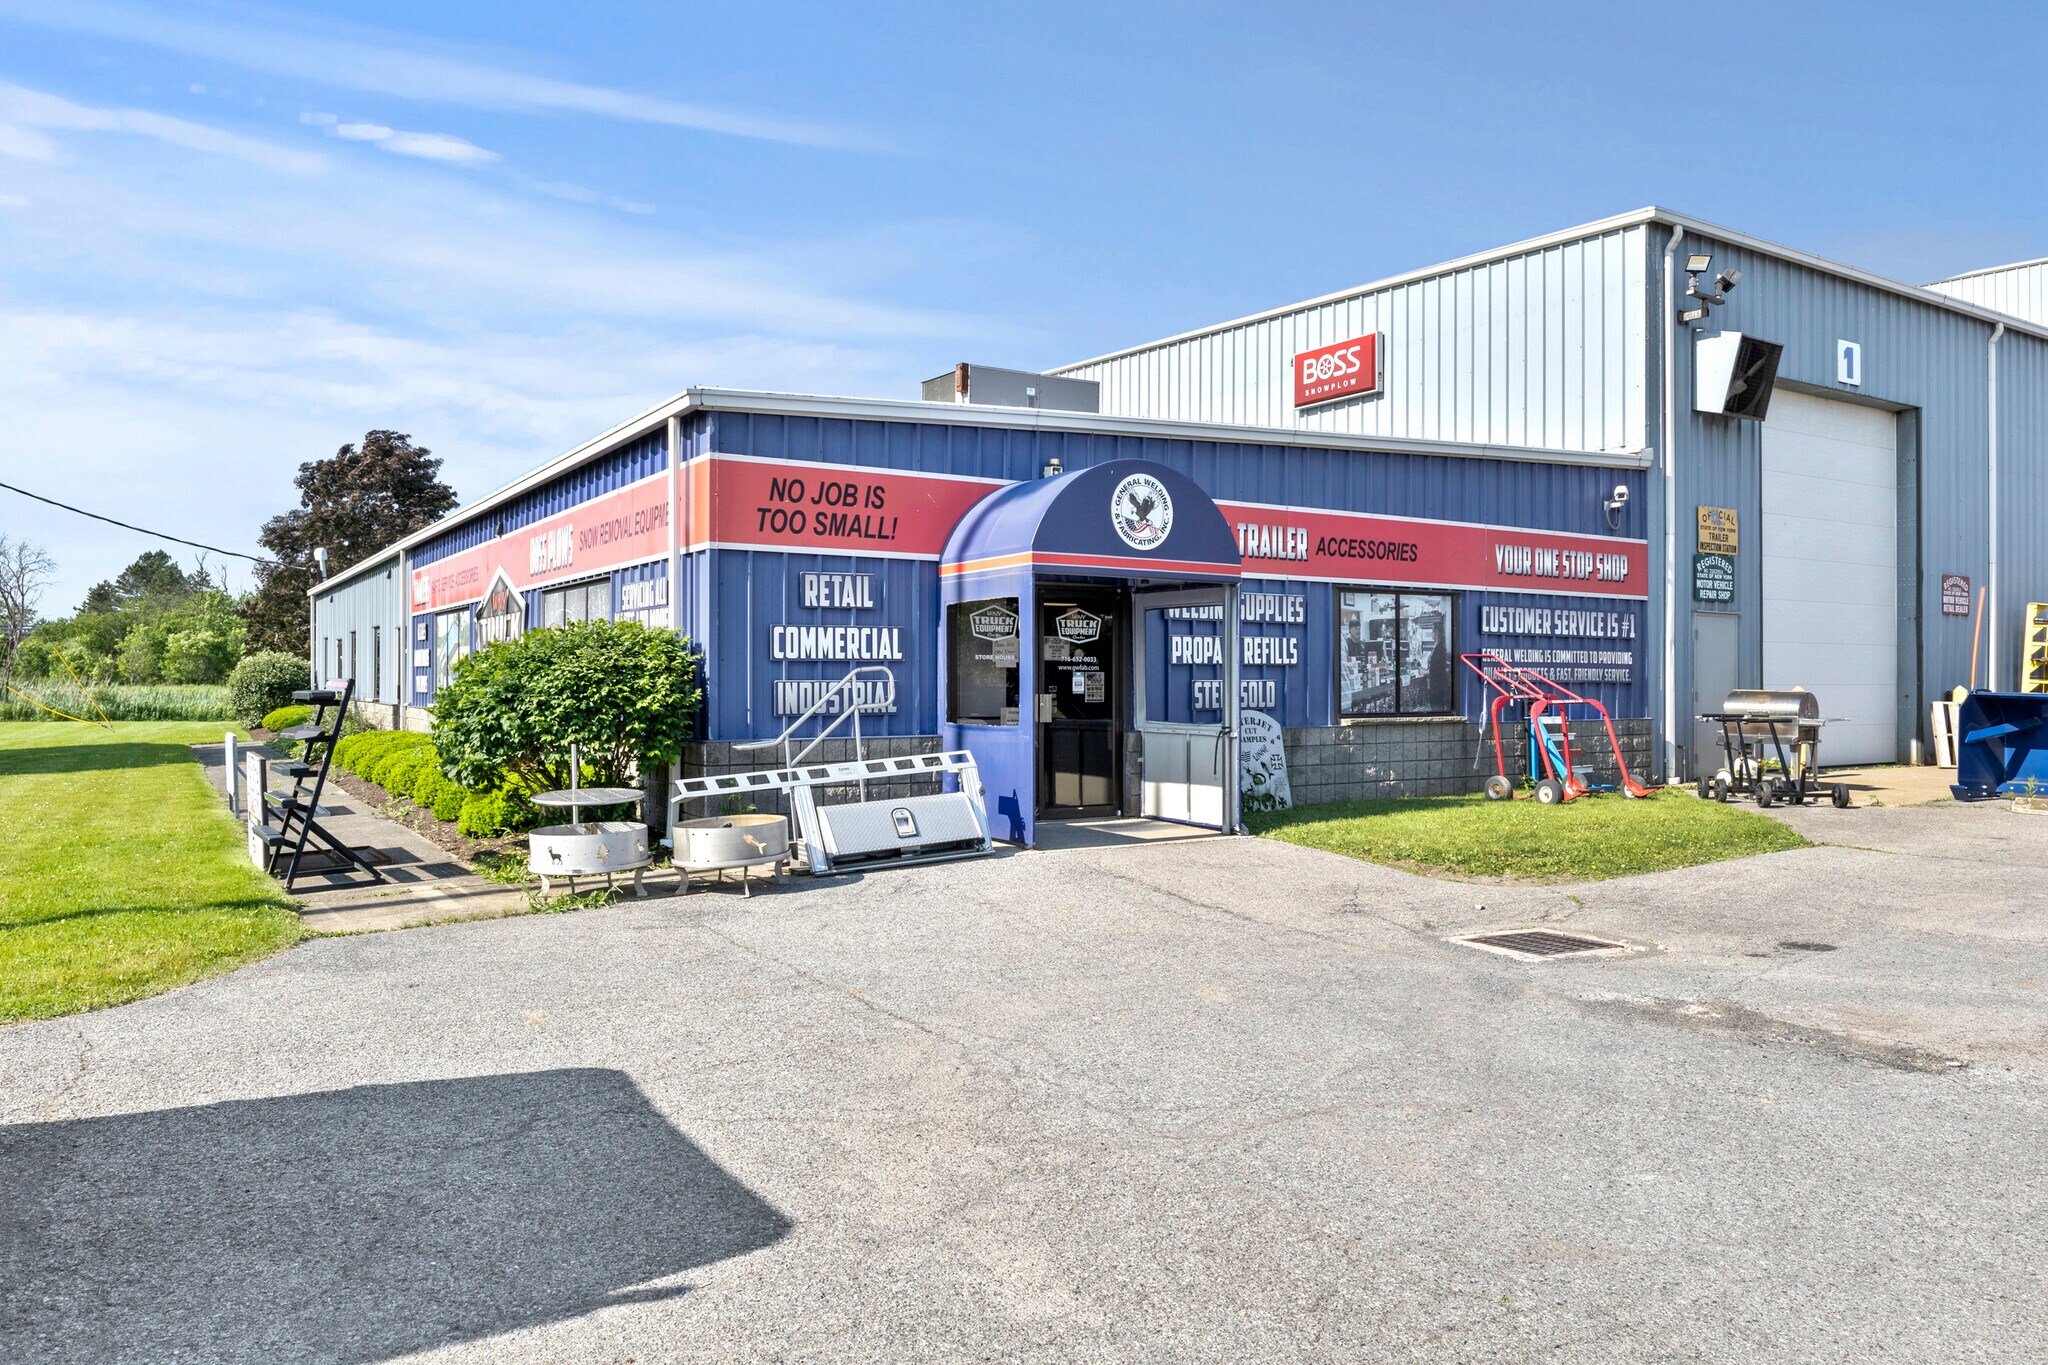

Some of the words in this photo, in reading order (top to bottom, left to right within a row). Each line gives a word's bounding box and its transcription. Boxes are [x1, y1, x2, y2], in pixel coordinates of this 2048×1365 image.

[1303, 345, 1360, 385] BOSS
[1844, 347, 1853, 379] 1
[1305, 378, 1356, 396] SNOWPLOW
[769, 478, 805, 503] NO
[811, 481, 858, 507] JOB
[864, 485, 885, 509] IS
[1115, 478, 1141, 506] GENERAL
[1144, 478, 1170, 511] WELDING
[580, 526, 599, 551] SNOW
[600, 514, 632, 545] REMOVAL
[634, 502, 669, 535] EQUIPME
[757, 508, 806, 534] TOO
[813, 511, 898, 540] SMALL!
[1702, 510, 1735, 526] OFCIAL
[1117, 521, 1162, 546] FABRICATING,
[1160, 518, 1170, 535] INC.
[1237, 523, 1308, 561] TRAILER
[1709, 532, 1728, 542] TRAILER
[1316, 536, 1418, 562] ACCESSORIES
[1700, 542, 1721, 552] INSPECTION
[1722, 544, 1737, 553] STATION
[1495, 544, 1532, 576] YOUR
[1535, 547, 1560, 578] ONE
[1562, 550, 1594, 580] STOP
[1596, 553, 1628, 582] SHOP
[1696, 556, 1733, 574] REGISTERED
[805, 574, 873, 607] RETAIL
[1697, 579, 1713, 589] MOTOR
[1714, 580, 1733, 590] VEHICLE
[1700, 589, 1717, 599] REPAIR
[1718, 590, 1730, 600] SHOP
[973, 616, 1015, 625] TRUCK
[1168, 605, 1223, 619] WELDIN
[1241, 594, 1304, 623] SUPPLIES
[975, 624, 1013, 633] EQUIPMENT
[1059, 620, 1098, 628] TRUCK
[1061, 628, 1097, 636] EQUIPMENT
[1482, 606, 1551, 634] CUSTOMER
[1554, 610, 1604, 637] SERVICE
[1607, 612, 1618, 637] IS
[1622, 613, 1635, 638] #1
[773, 626, 902, 659] COMMERCIAL
[1172, 636, 1223, 664] PROPA
[1244, 637, 1297, 665] REFILLS
[1058, 665, 1099, 673] www.gwfab.com
[1482, 648, 1512, 662] GENERAL
[1514, 649, 1543, 663] WELDING
[1544, 650, 1551, 663] IS
[1552, 650, 1588, 664] COMMITTED
[1589, 651, 1597, 664] TO
[1598, 652, 1633, 665] PROVIDING
[1550, 668, 1555, 680] &
[1574, 668, 1603, 681] FRIENDLY
[1604, 669, 1631, 681] SERVICE.
[777, 682, 897, 715] INDUSTRIAL
[1194, 681, 1223, 709] STE
[1241, 681, 1275, 708] SOLD
[1240, 717, 1273, 732] TERJET
[1241, 735, 1266, 743] AMPLES
